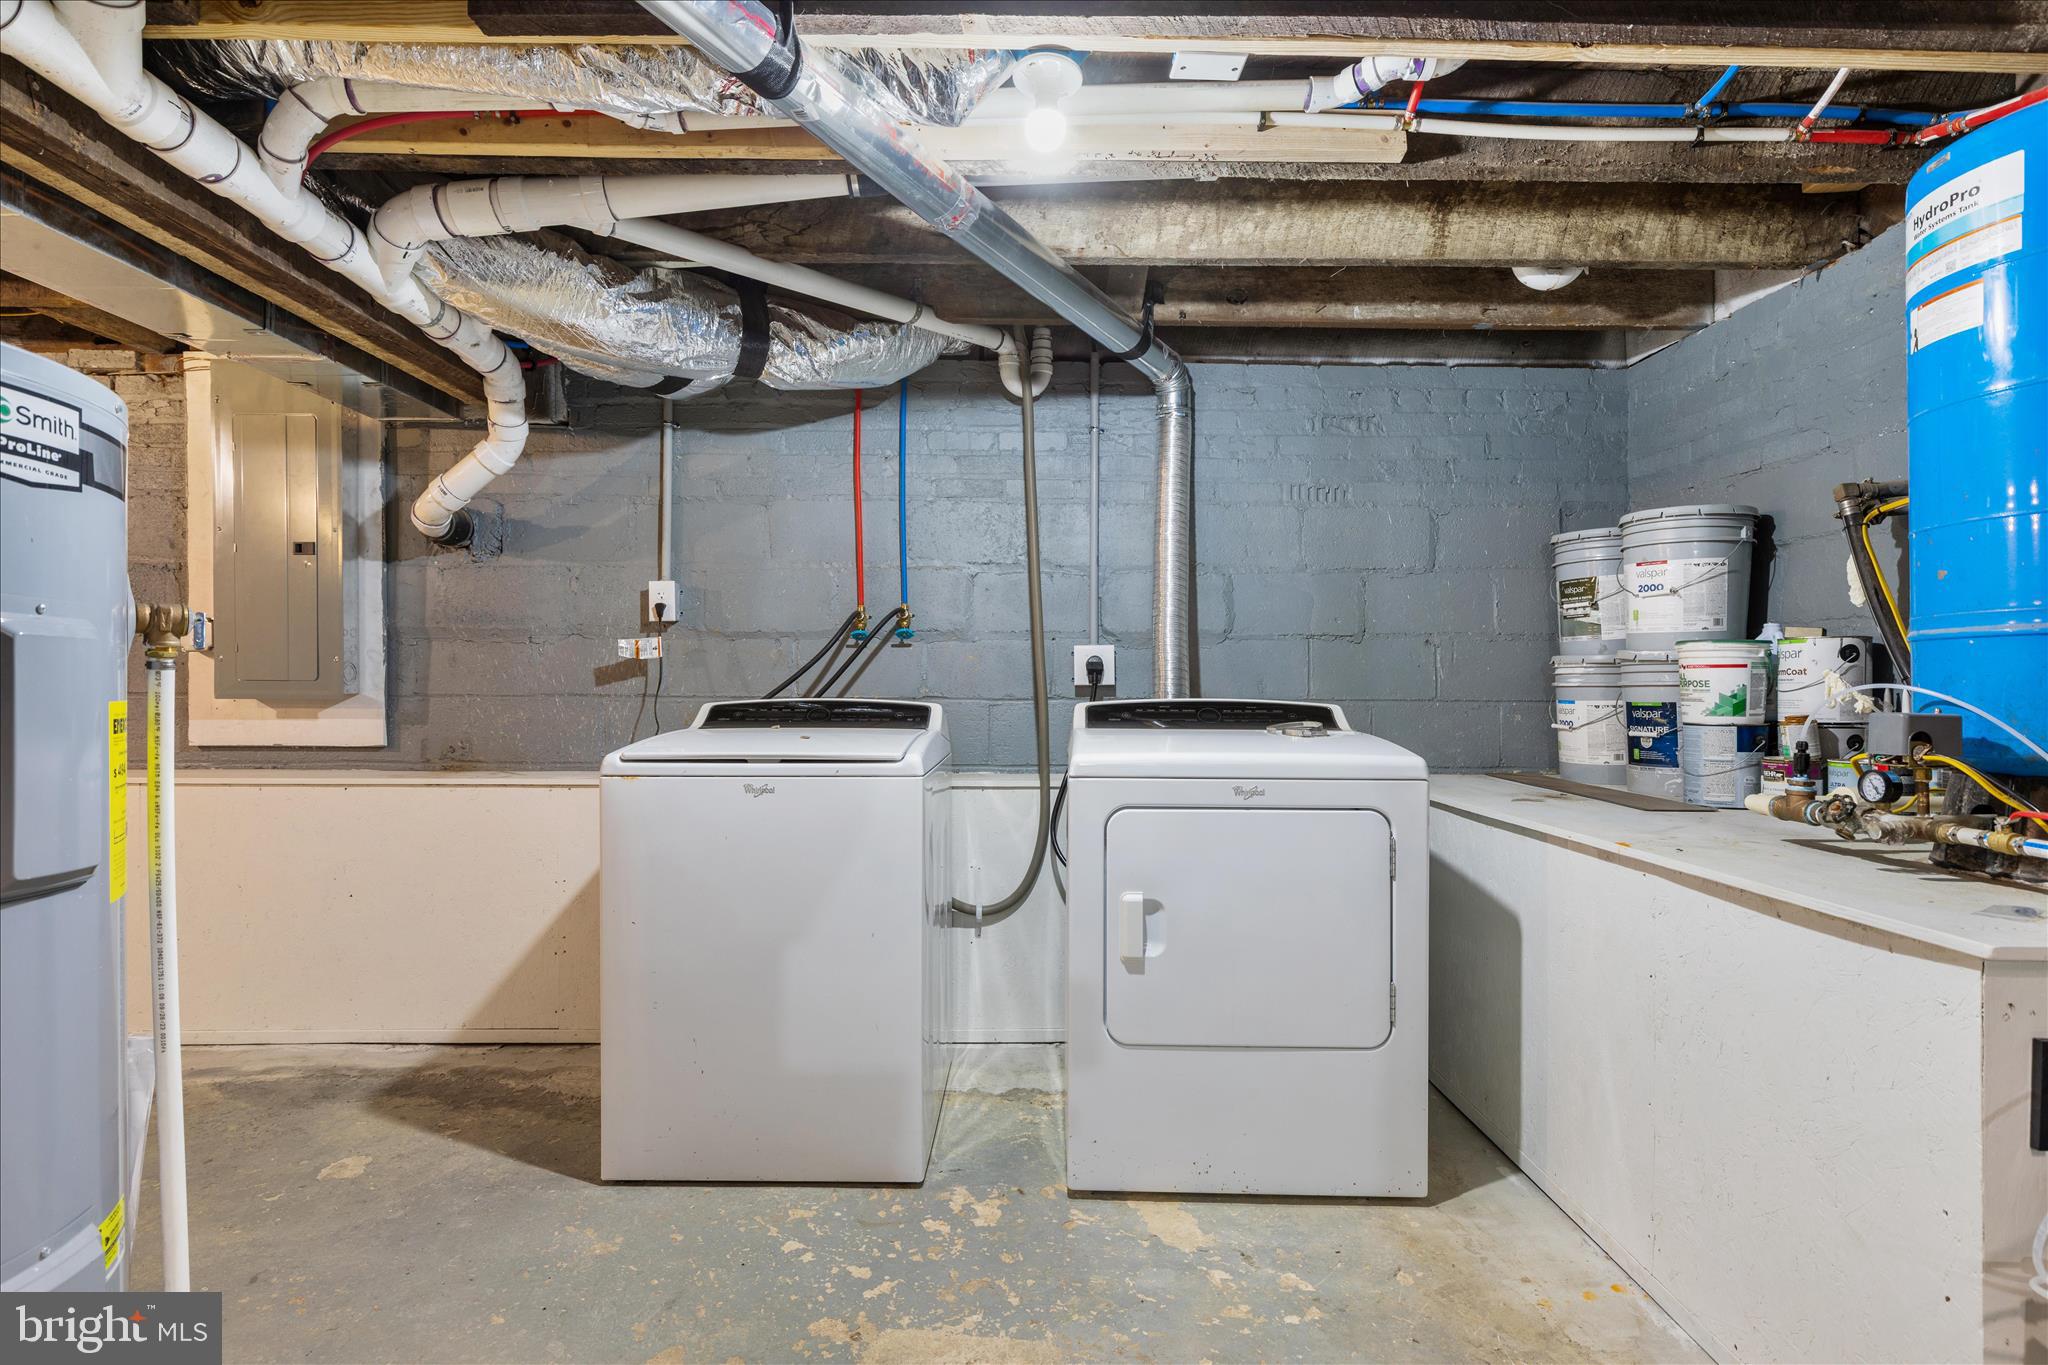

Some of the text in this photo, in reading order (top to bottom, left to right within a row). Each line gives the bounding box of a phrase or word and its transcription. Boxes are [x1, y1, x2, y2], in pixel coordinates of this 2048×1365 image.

[1913, 186, 1980, 231] HydroPro
[1928, 212, 1956, 230] Systems
[1959, 201, 1978, 213] Tank
[16, 405, 74, 440] Smith
[0, 460, 67, 479] MMERCIAL GRADE
[1636, 568, 1668, 579] valspar
[1638, 583, 1664, 593] 2000
[1631, 708, 1662, 720] valspar
